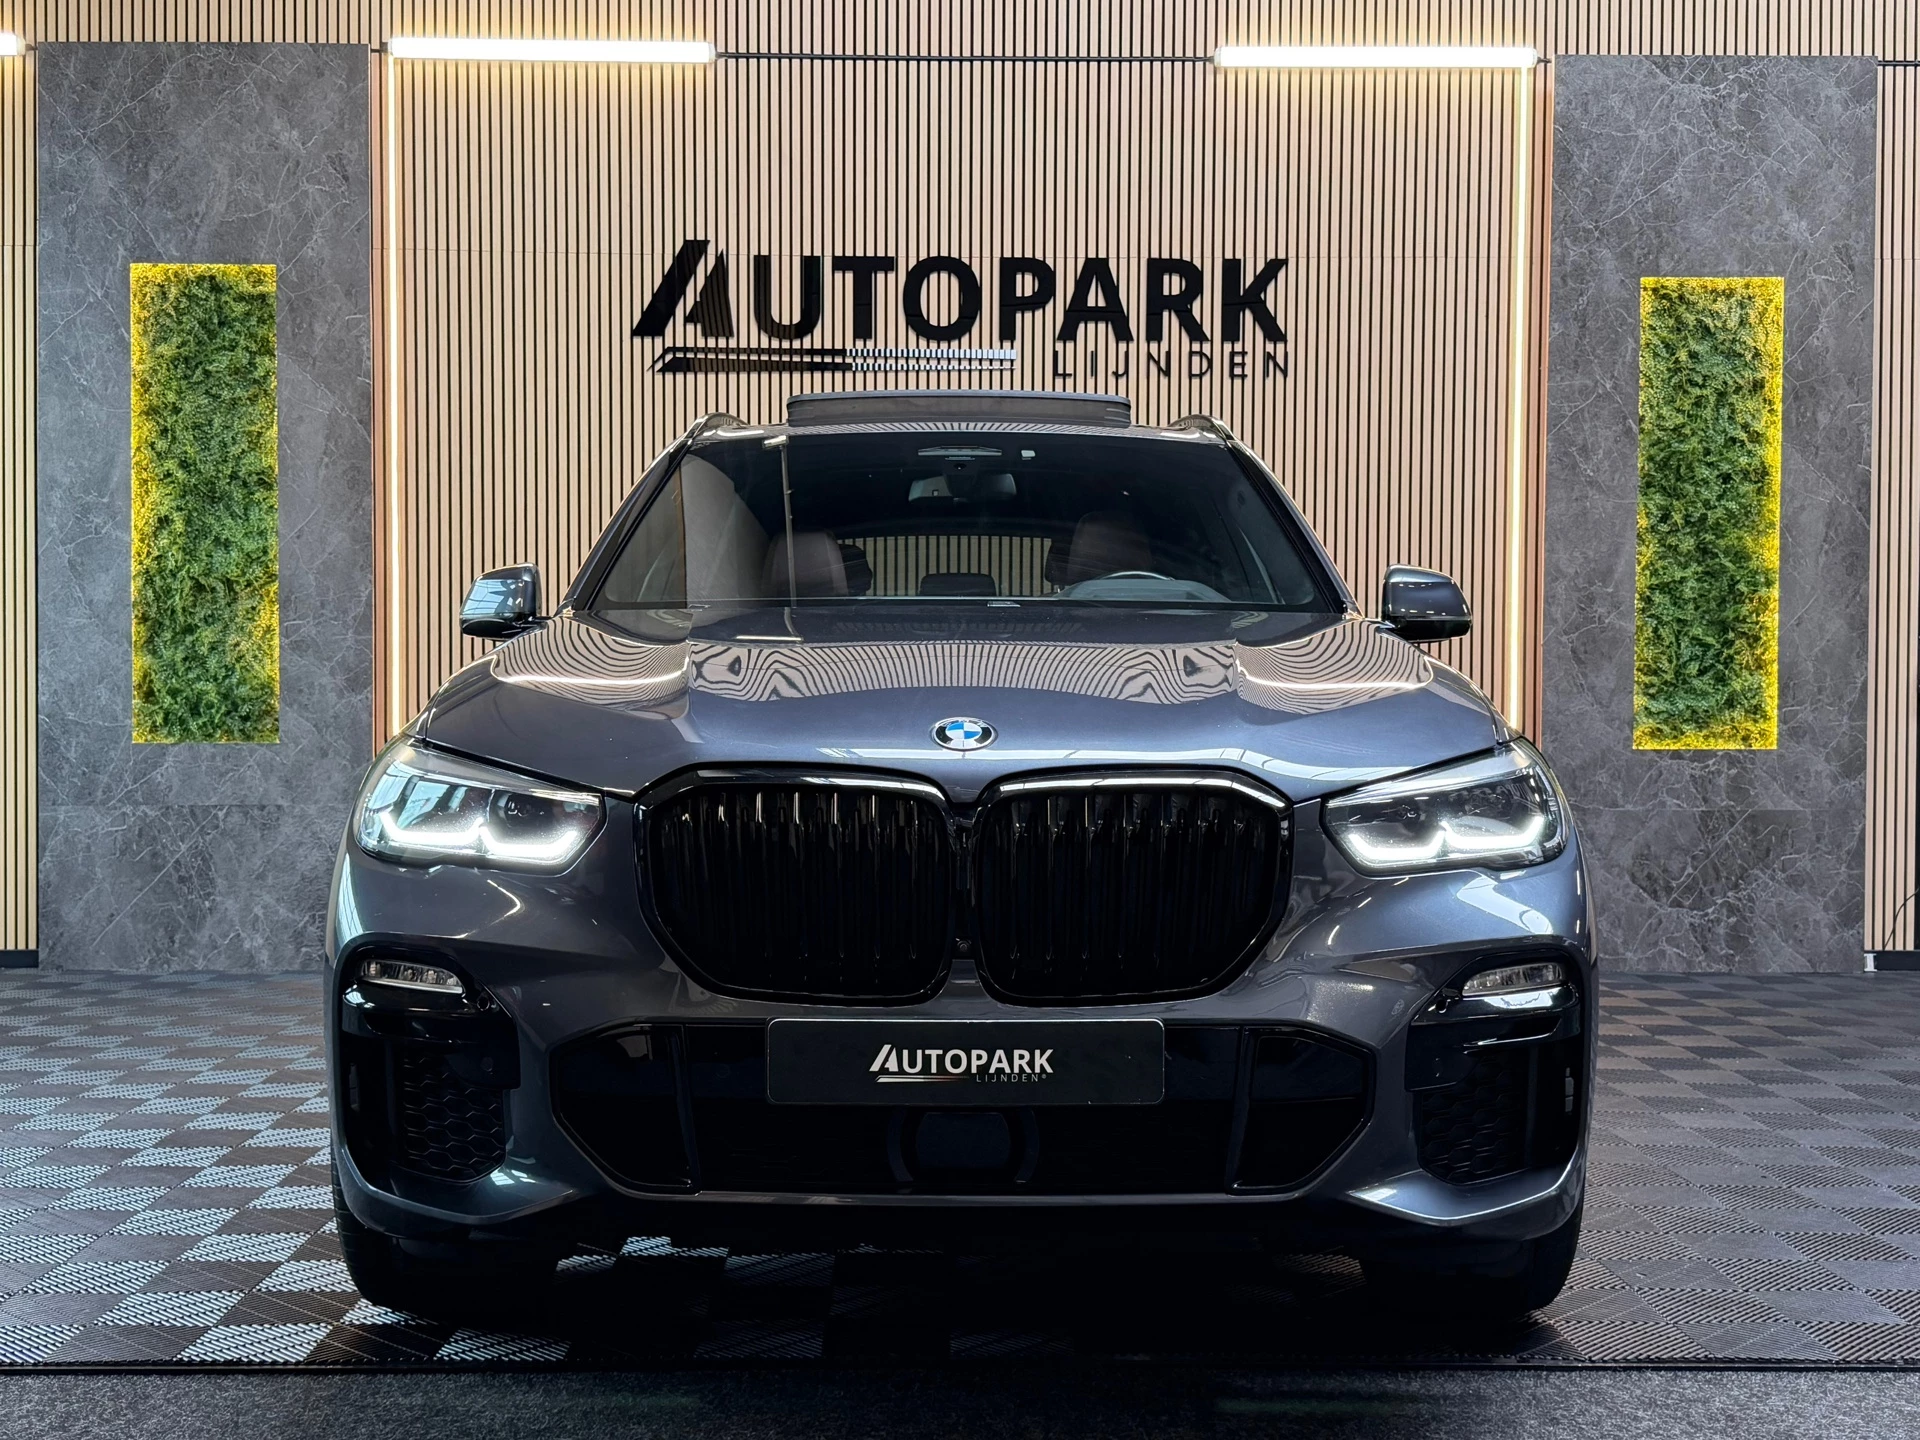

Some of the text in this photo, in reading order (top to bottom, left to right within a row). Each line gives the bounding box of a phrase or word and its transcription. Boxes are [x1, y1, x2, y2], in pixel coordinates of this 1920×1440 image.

[632, 239, 1288, 342] AUTOPARK
[1053, 350, 1288, 378] LIJNDEN
[869, 1044, 1054, 1073] AUTOPARK
